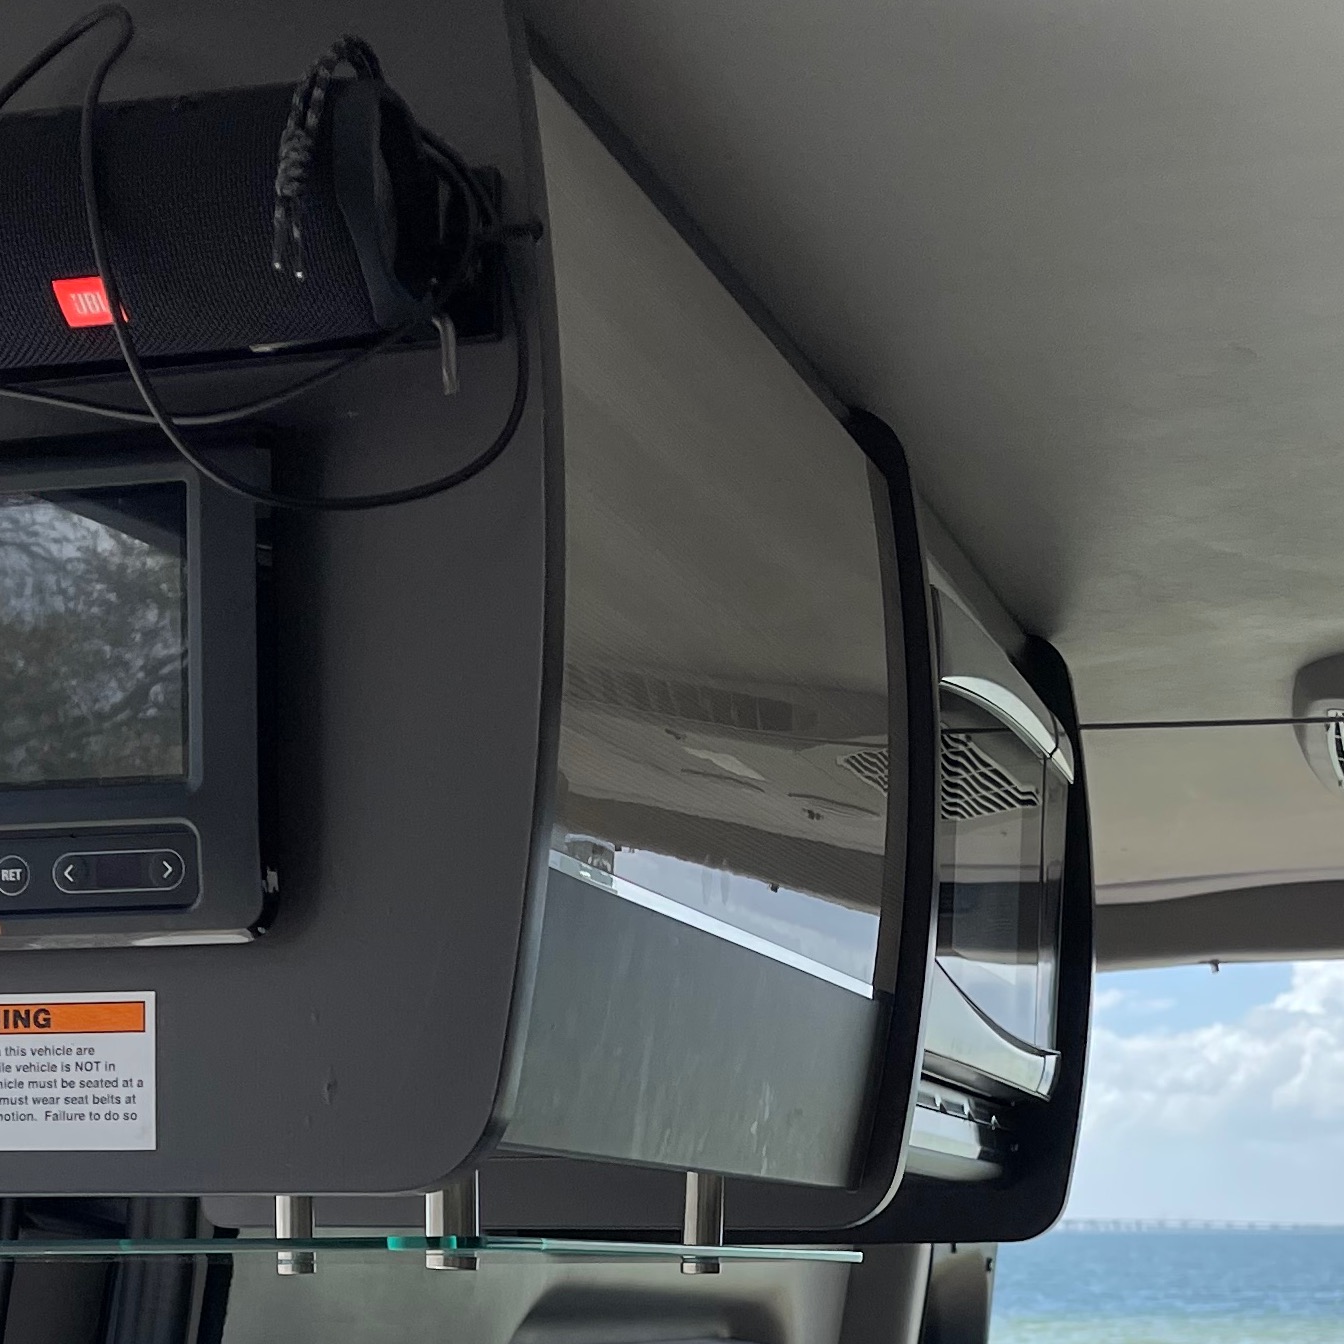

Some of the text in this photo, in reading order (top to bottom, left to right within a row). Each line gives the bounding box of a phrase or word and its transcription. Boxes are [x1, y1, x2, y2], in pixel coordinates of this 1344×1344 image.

[1, 869, 22, 882] RET
[4, 1045, 27, 1057] this
[29, 1044, 73, 1057] vehicle
[75, 1046, 95, 1056] are
[15, 1061, 58, 1073] vehicle
[60, 1061, 71, 1072] is
[74, 1060, 101, 1072] NOT
[104, 1060, 115, 1071] in
[27, 1078, 57, 1089] must
[60, 1077, 76, 1089] be
[78, 1076, 118, 1088] seated
[121, 1077, 133, 1088] at
[136, 1079, 143, 1088] a
[31, 1096, 60, 1105] wear
[63, 1094, 89, 1105] seat
[91, 1093, 121, 1105] belts
[124, 1093, 136, 1104] at
[44, 1109, 86, 1121] Failure
[88, 1111, 100, 1121] to
[103, 1109, 120, 1121] do
[122, 1112, 137, 1121] so
